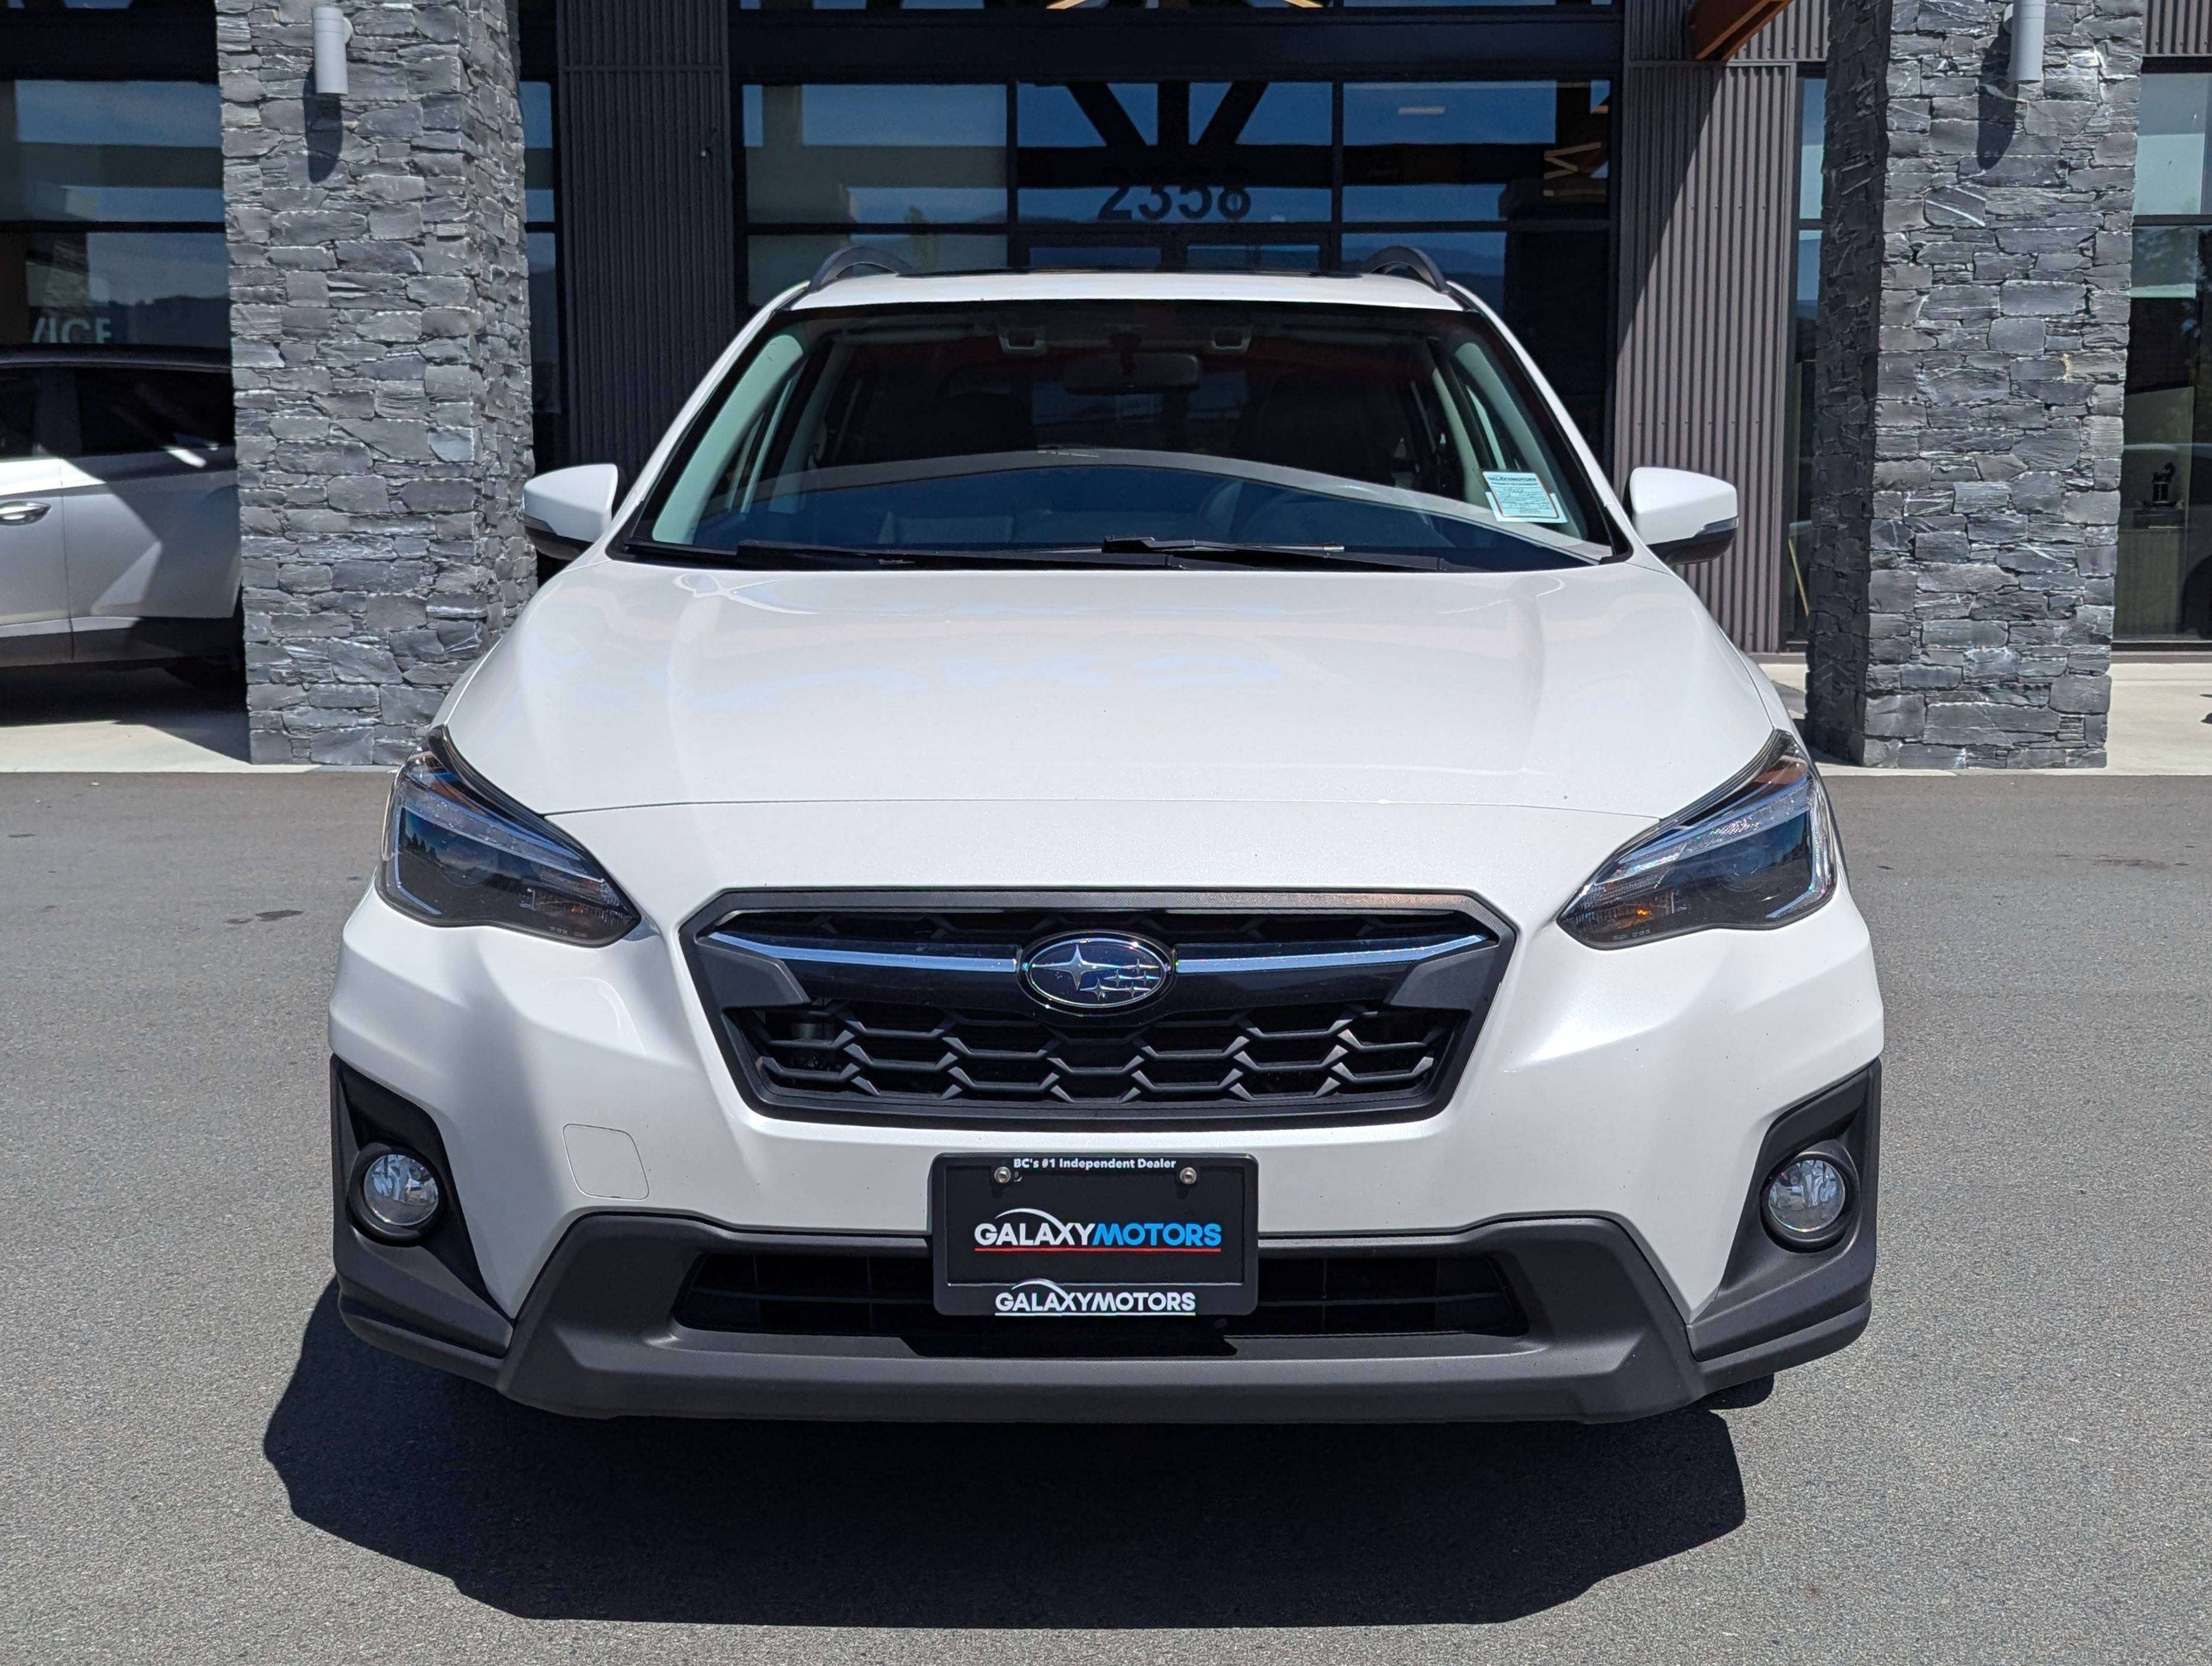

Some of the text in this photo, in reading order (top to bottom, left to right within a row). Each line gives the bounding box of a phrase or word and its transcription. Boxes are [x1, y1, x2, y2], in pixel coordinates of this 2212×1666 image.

[1014, 1158, 1176, 1170] BC's #1 Independent Dealer
